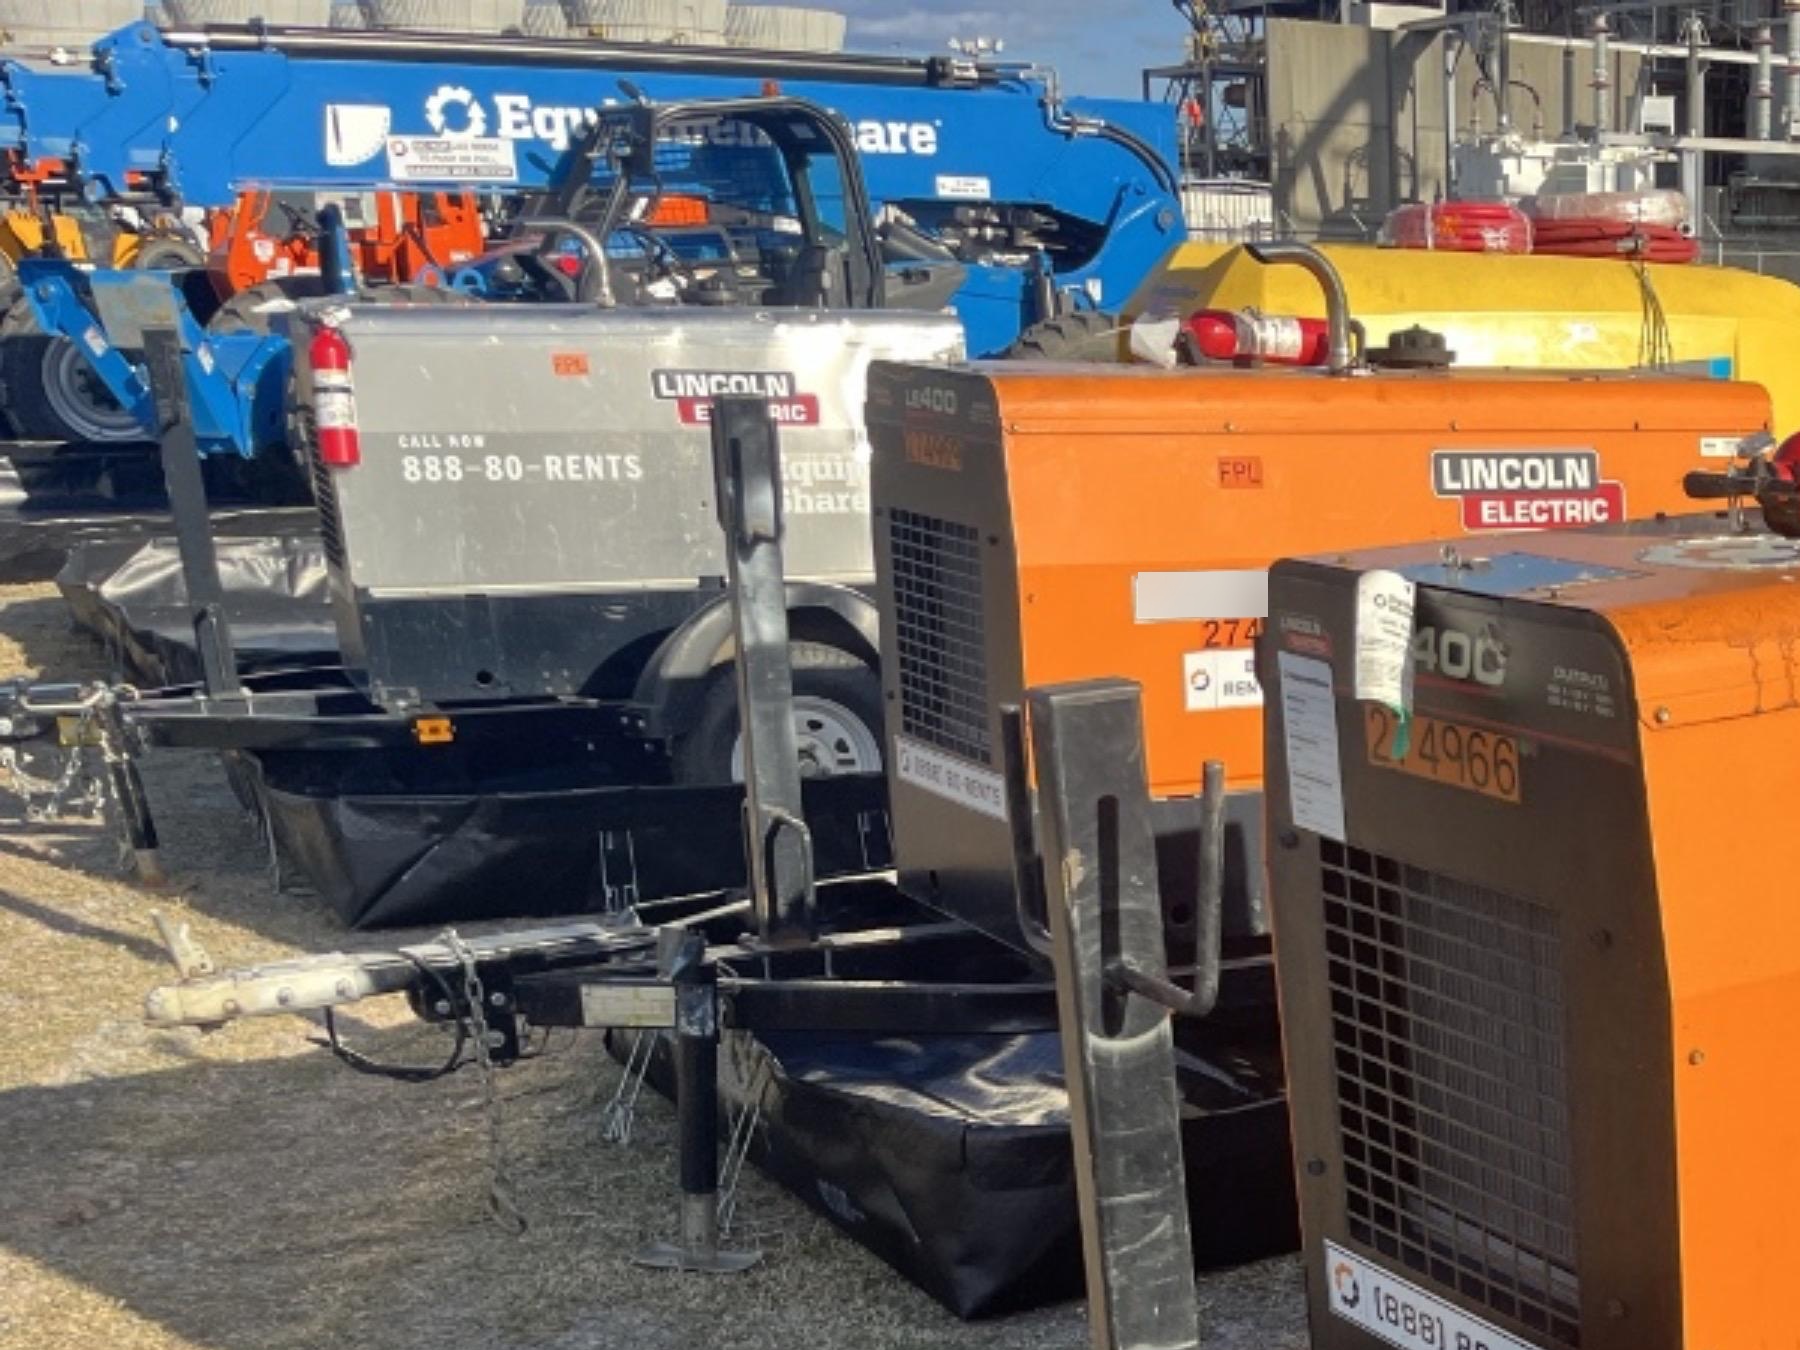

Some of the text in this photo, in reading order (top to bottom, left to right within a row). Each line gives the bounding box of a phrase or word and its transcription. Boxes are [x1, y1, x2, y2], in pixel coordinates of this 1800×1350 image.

[658, 373, 790, 398] LINCOLN
[694, 403, 809, 422] ERIC
[398, 434, 485, 448] CALL NOW
[402, 454, 643, 482] 888-80-RENTS
[1219, 461, 1261, 484] FPL
[1441, 457, 1591, 490] LINCOLN
[1480, 498, 1609, 525] ELECTRIC
[1202, 617, 1258, 649] 274
[1412, 622, 1508, 686] 400
[1369, 704, 1518, 796] 24966
